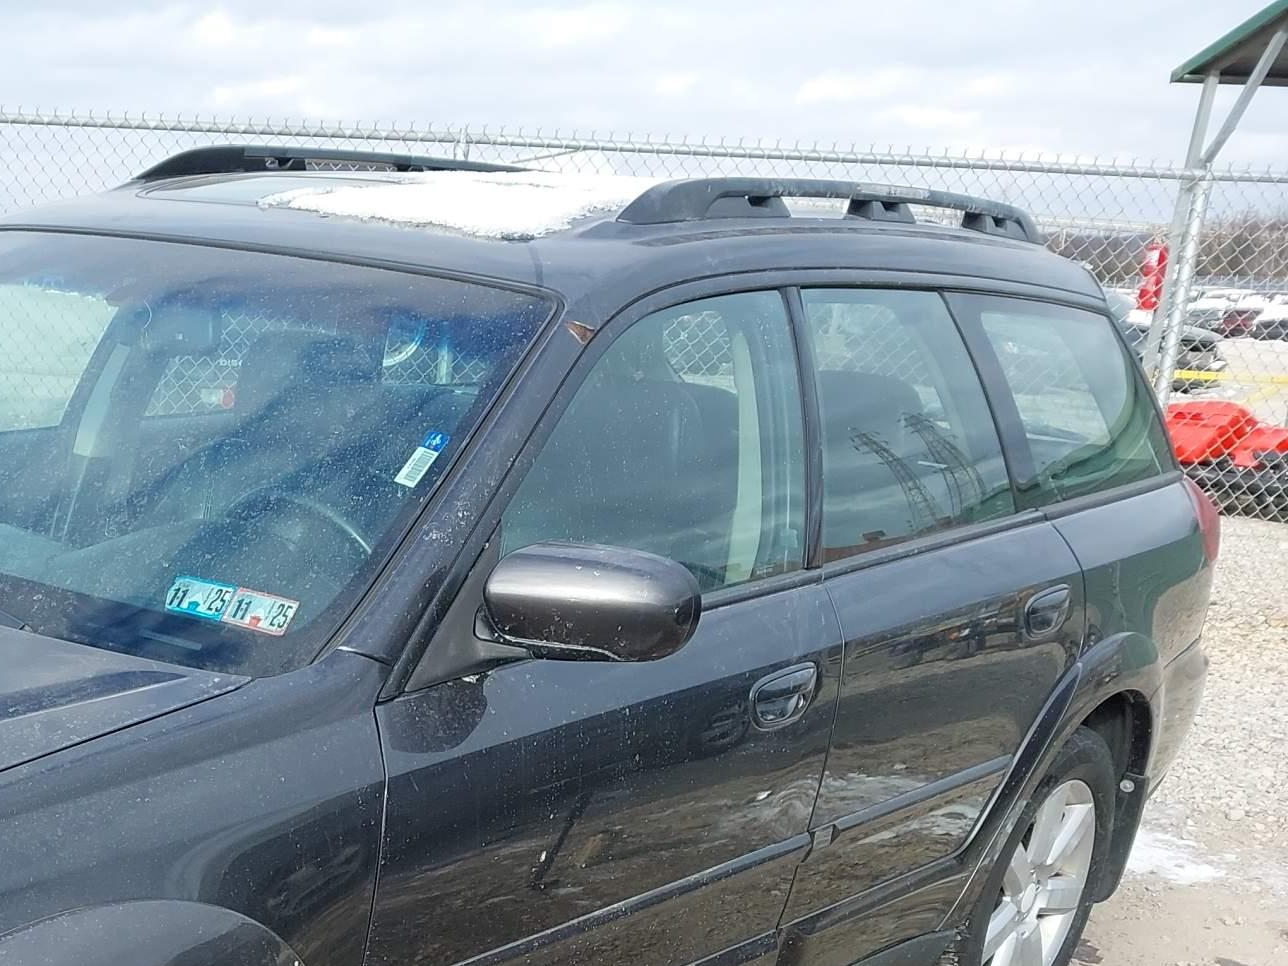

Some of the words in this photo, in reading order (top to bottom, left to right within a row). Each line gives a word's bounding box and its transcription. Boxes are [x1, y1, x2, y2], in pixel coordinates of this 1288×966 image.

[168, 587, 189, 609] 11
[207, 588, 232, 612] 25
[232, 597, 253, 620] 11
[269, 604, 294, 628] 25
